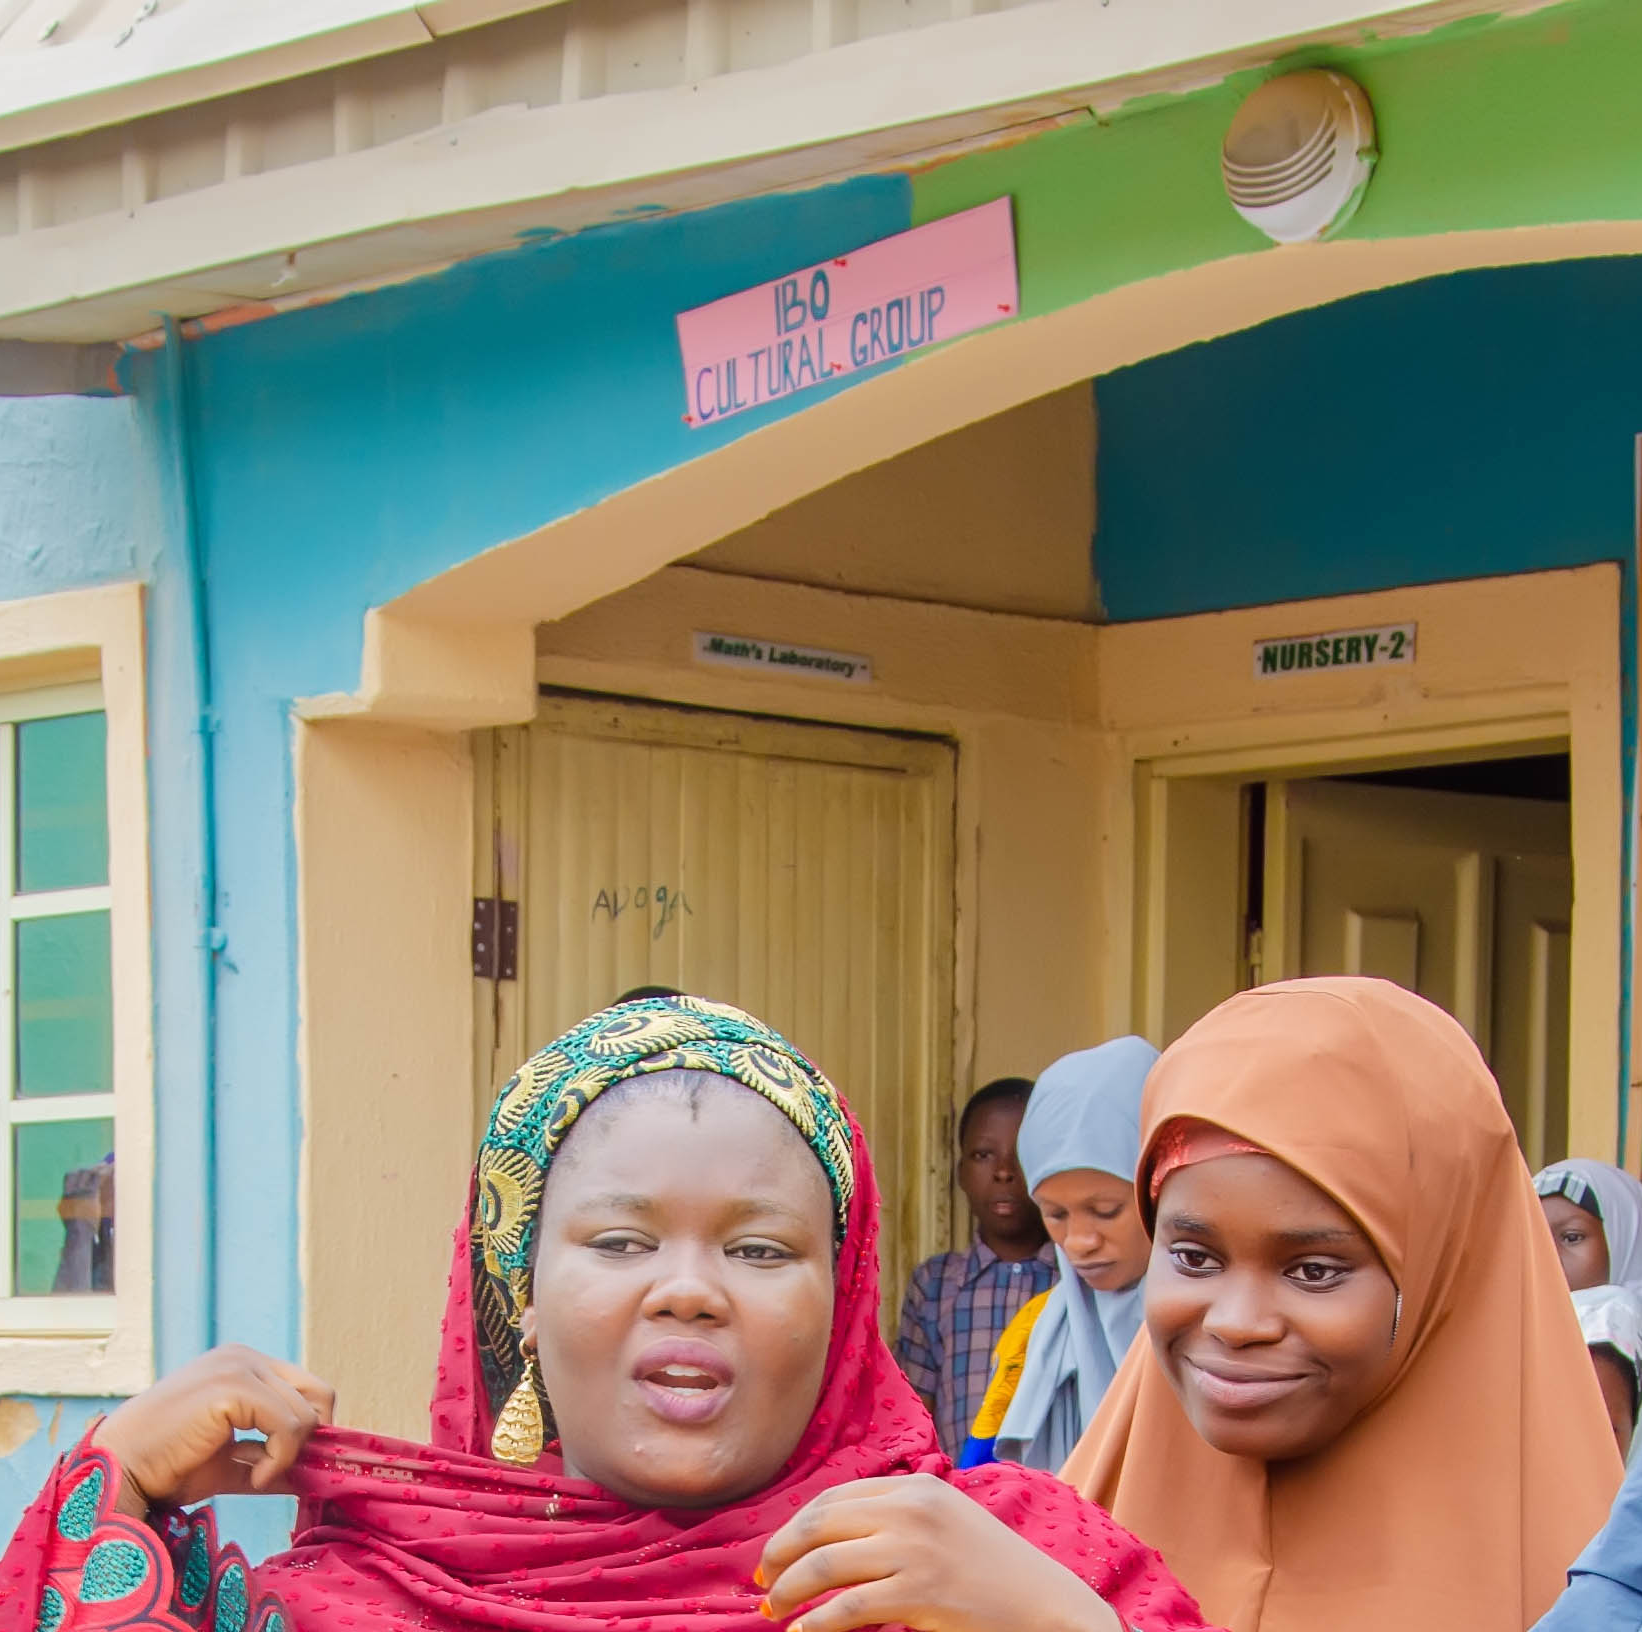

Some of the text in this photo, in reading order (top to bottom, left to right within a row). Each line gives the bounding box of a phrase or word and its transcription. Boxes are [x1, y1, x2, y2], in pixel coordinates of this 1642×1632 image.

[774, 268, 830, 336] IBO
[695, 286, 946, 421] CULTURAL GROUP
[709, 636, 855, 678] Math's Laboratory
[1261, 630, 1406, 674] NURSERY-2
